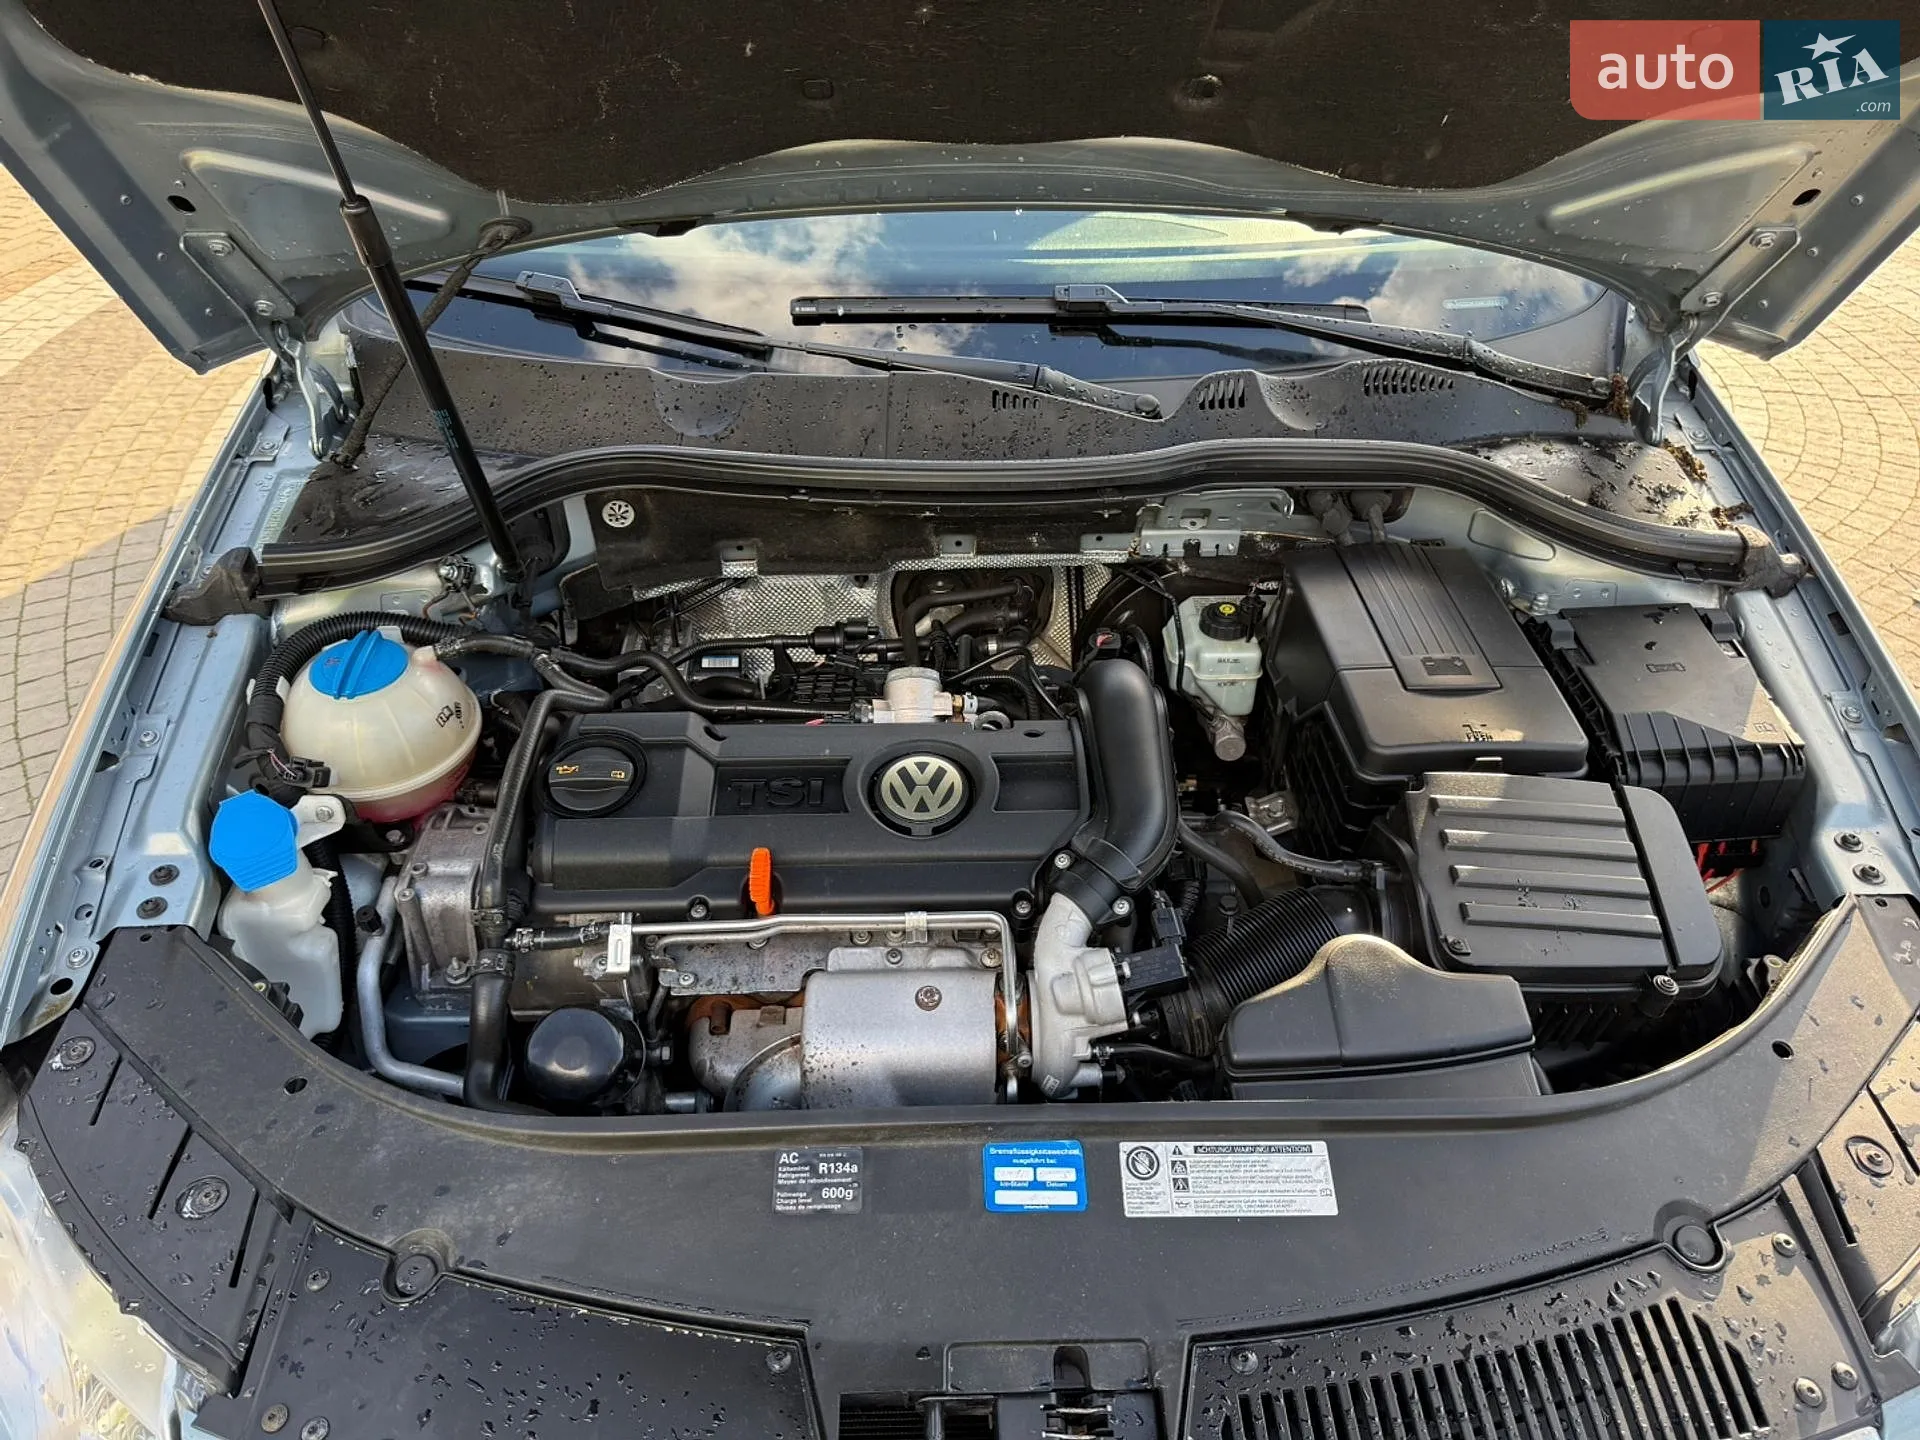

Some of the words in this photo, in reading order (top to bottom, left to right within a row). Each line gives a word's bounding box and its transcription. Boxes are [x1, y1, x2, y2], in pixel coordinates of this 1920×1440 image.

[730, 777, 826, 807] TSI
[779, 1152, 799, 1163] AC
[818, 1162, 859, 1174] R134a
[821, 1187, 854, 1200] 600g
